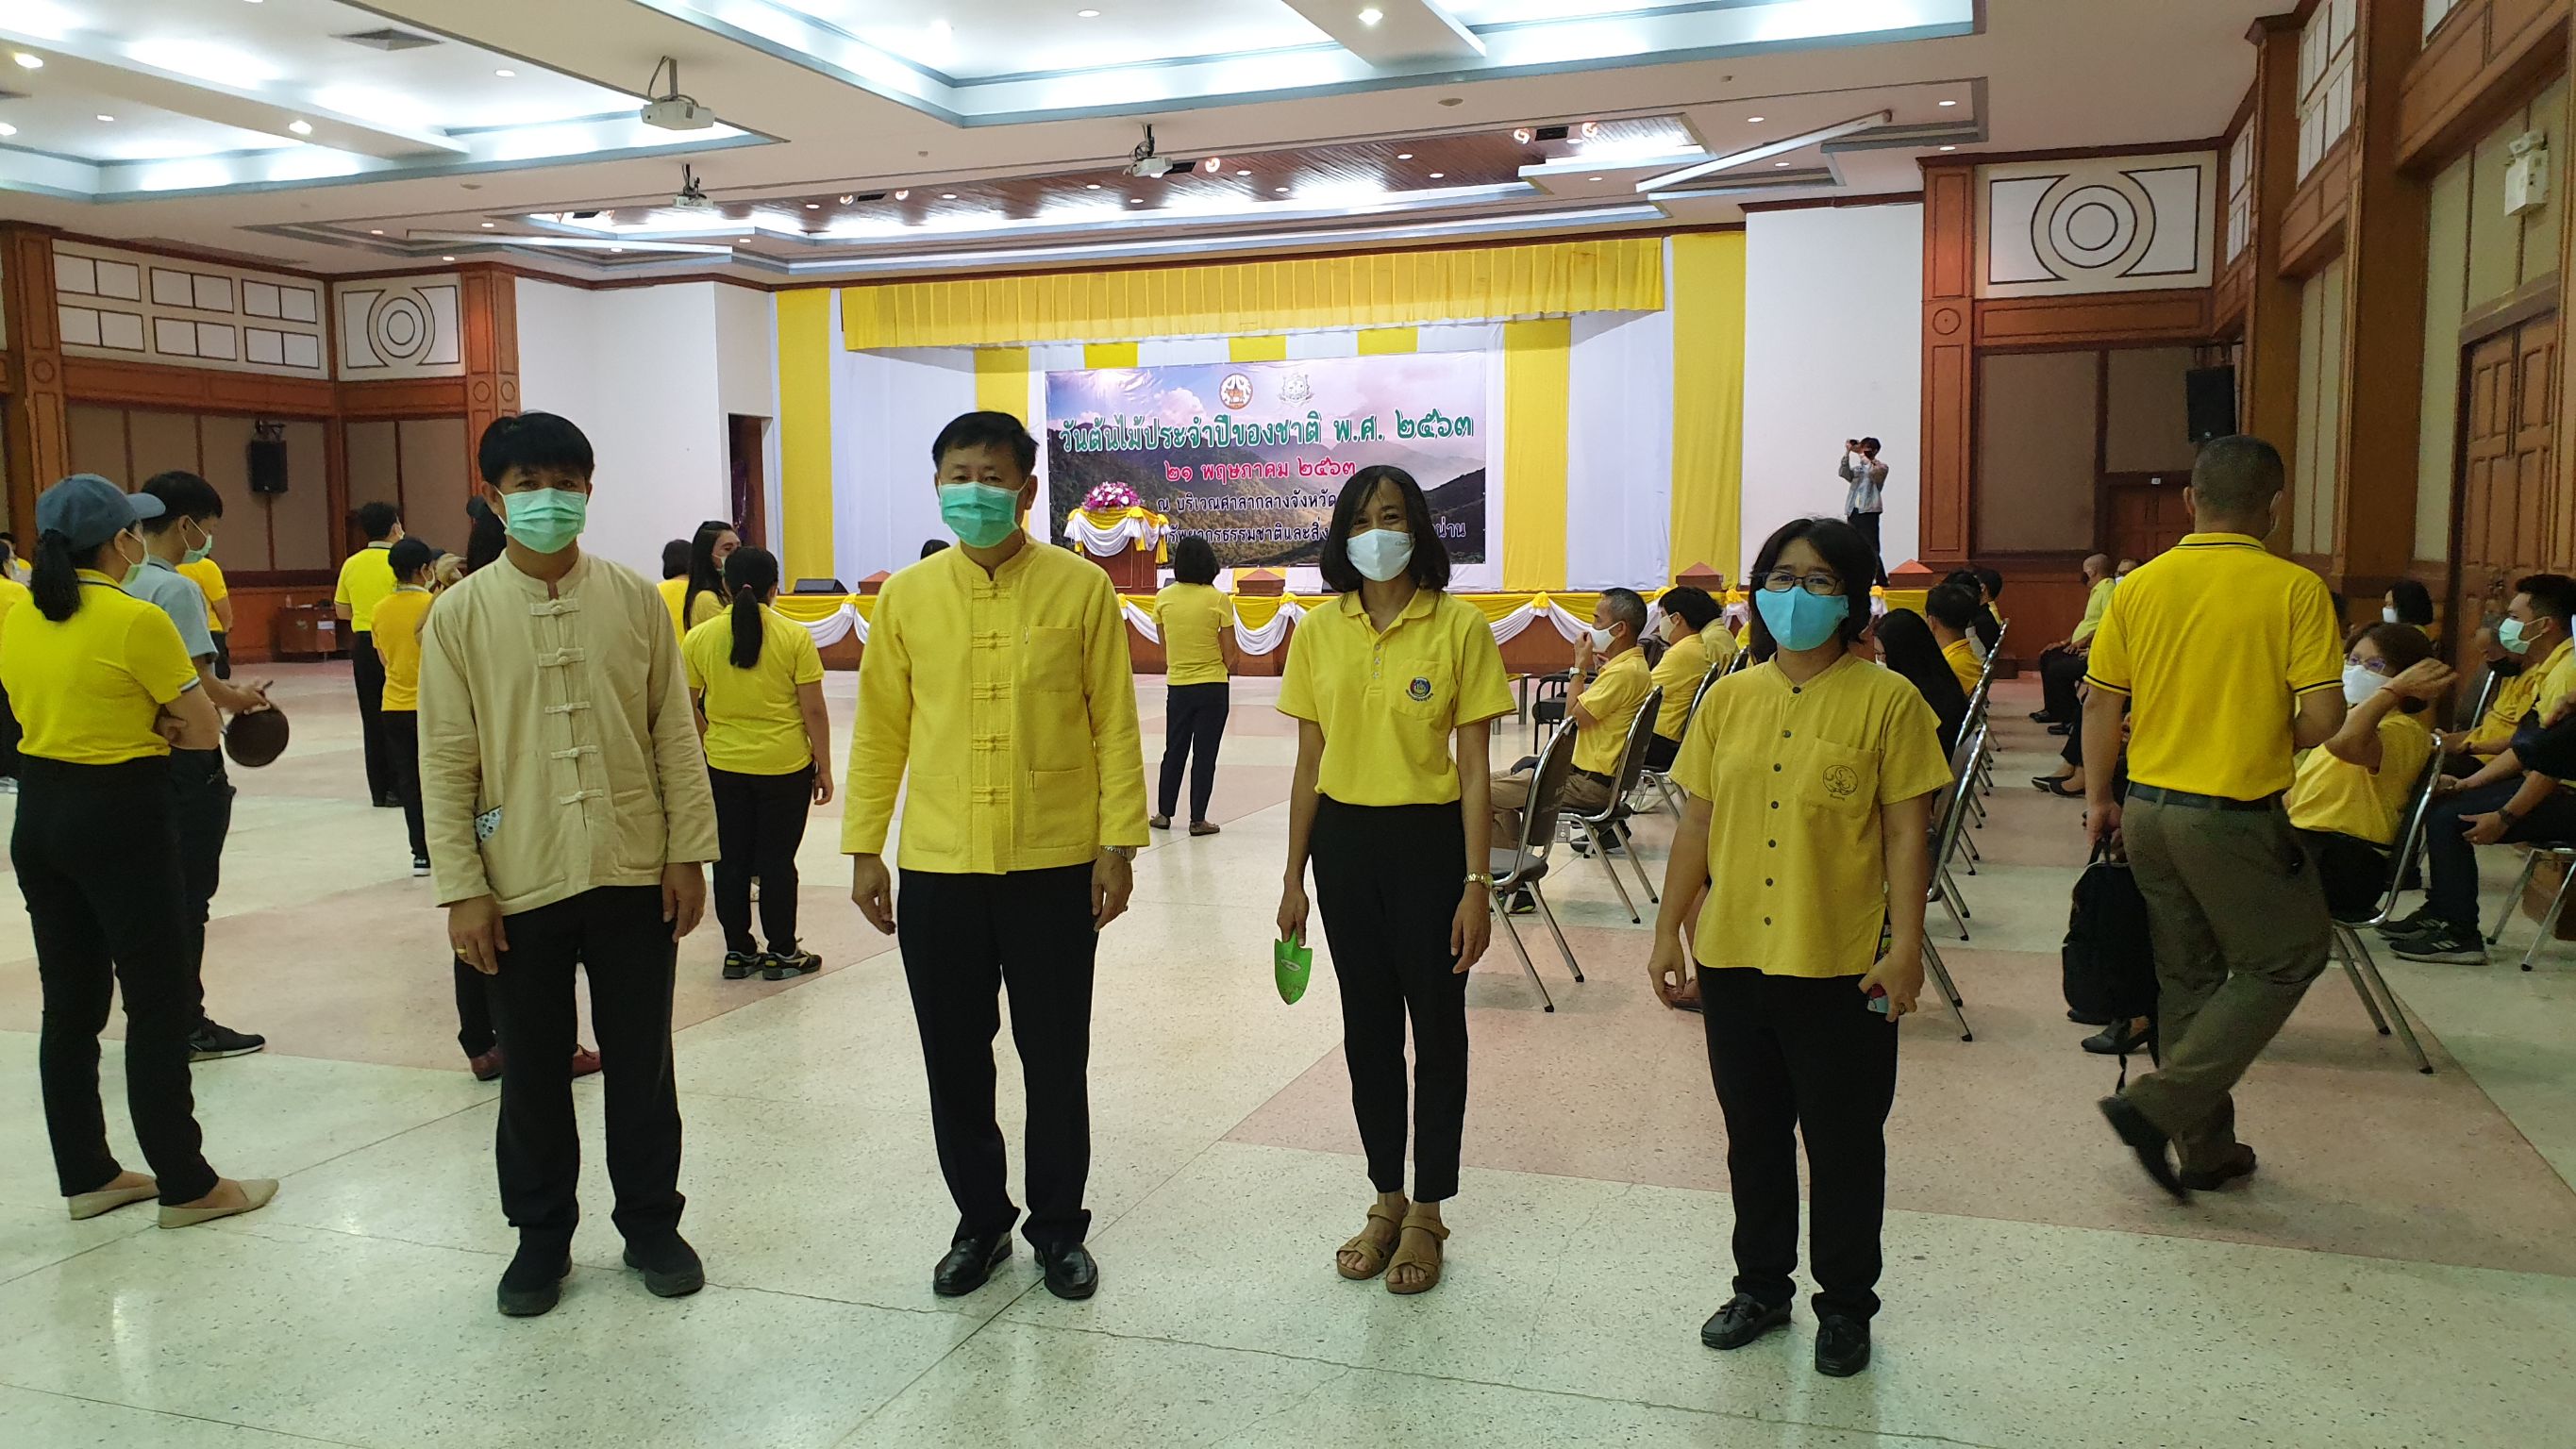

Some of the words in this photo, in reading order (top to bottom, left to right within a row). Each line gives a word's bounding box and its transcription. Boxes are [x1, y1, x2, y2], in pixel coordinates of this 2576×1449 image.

[1059, 410, 1322, 453] วันต้นไม้ประจำปีของชาติ
[1333, 416, 1384, 441] พ.ศ.
[1395, 408, 1474, 440] ๒๕๖๓
[1163, 460, 1194, 482] ๒๑
[1200, 460, 1289, 485] พฤษภาคม
[1297, 457, 1356, 478] ๒๕๖๓
[1157, 497, 1170, 511] ณ
[1177, 488, 1336, 511] บริเวณศาลากลางจังหวัด
